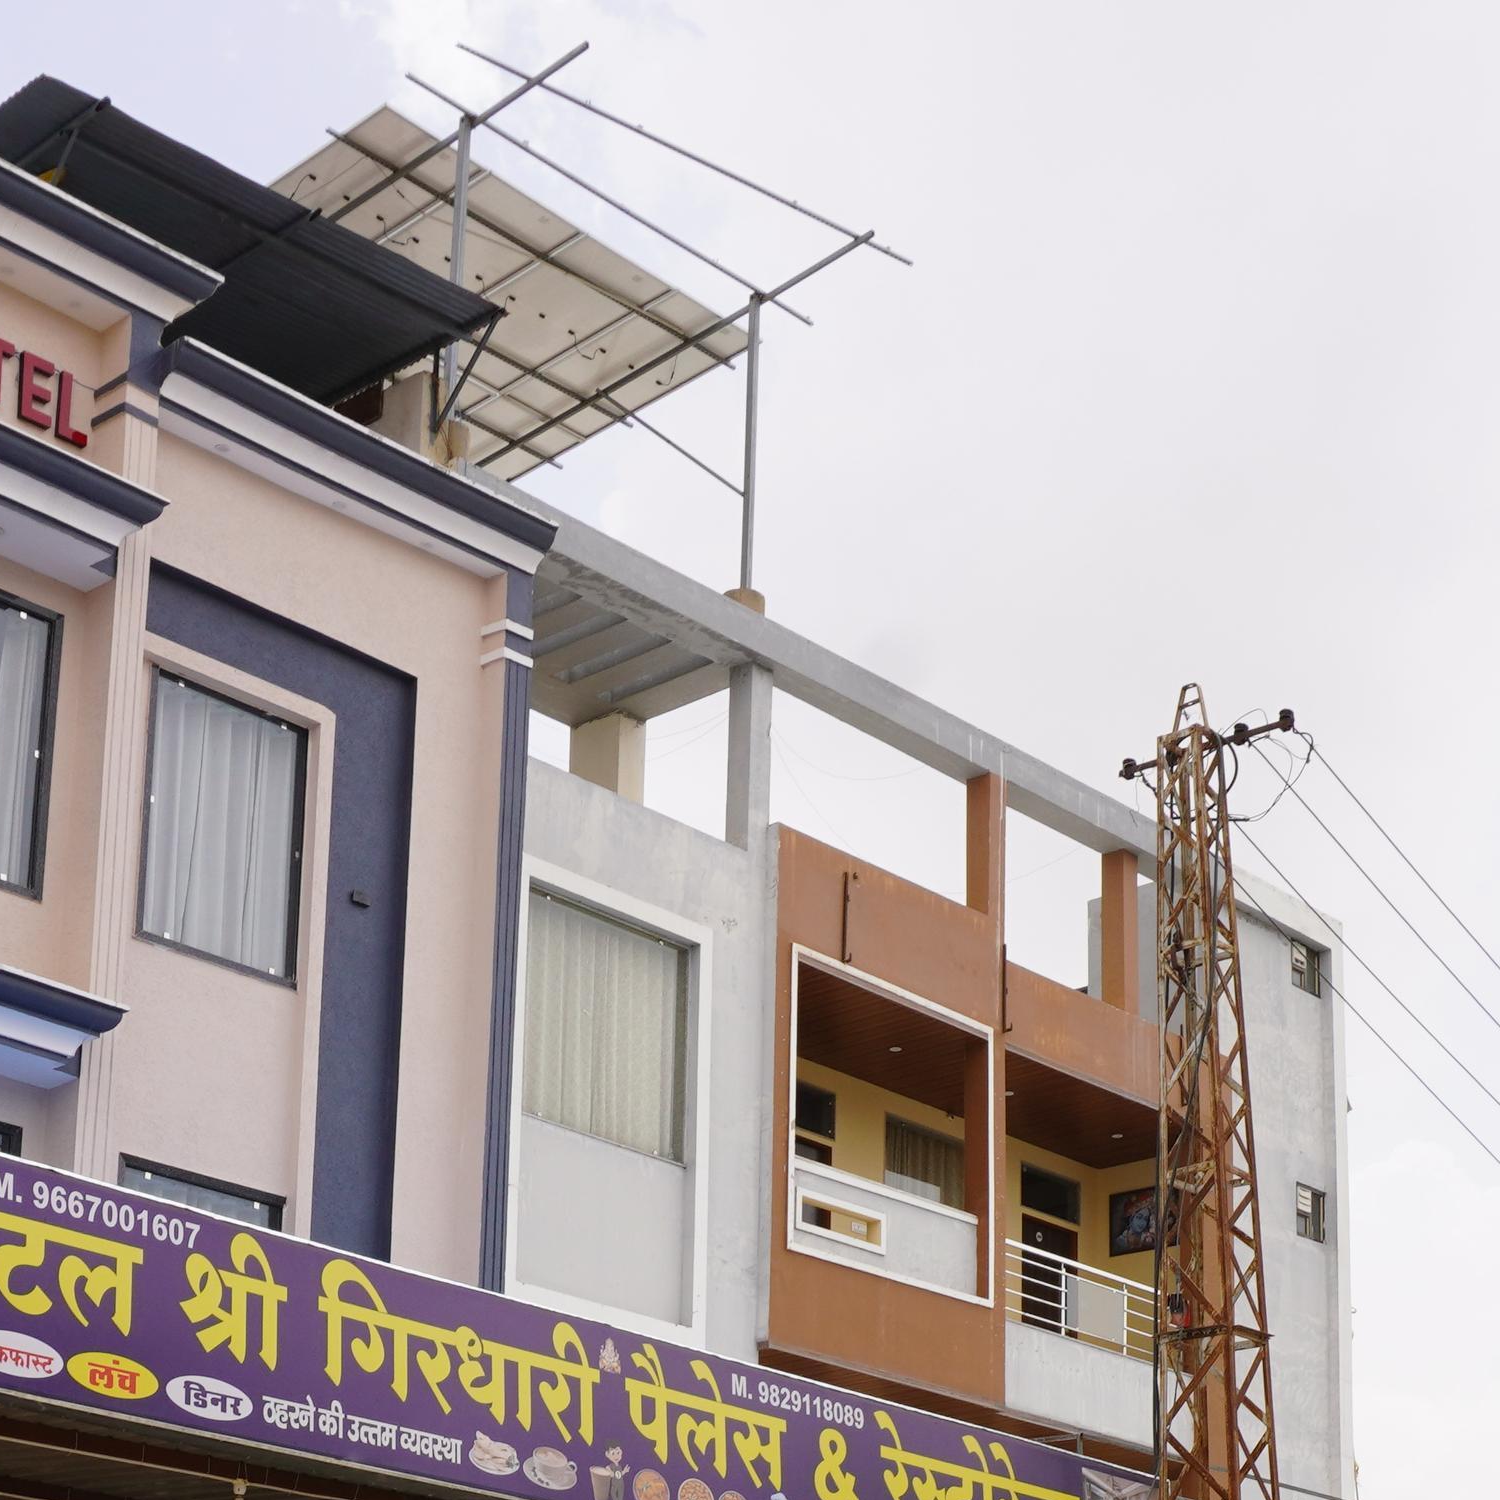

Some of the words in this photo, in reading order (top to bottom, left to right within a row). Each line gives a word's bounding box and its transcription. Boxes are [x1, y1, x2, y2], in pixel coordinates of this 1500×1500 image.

[32, 1180, 201, 1250] 9667001607
[87, 1360, 138, 1395] लंच
[179, 1232, 288, 1372] श्री
[318, 1259, 601, 1447] गिरधारी
[625, 1343, 787, 1492] पैलेस
[183, 1380, 244, 1417] डिनर
[262, 1394, 315, 1433] ठहरने
[317, 1398, 344, 1439] की
[346, 1417, 397, 1451] उत्तम
[399, 1429, 463, 1466] व्यवस्था
[731, 1373, 753, 1401] M.
[758, 1381, 865, 1430] 9829118089
